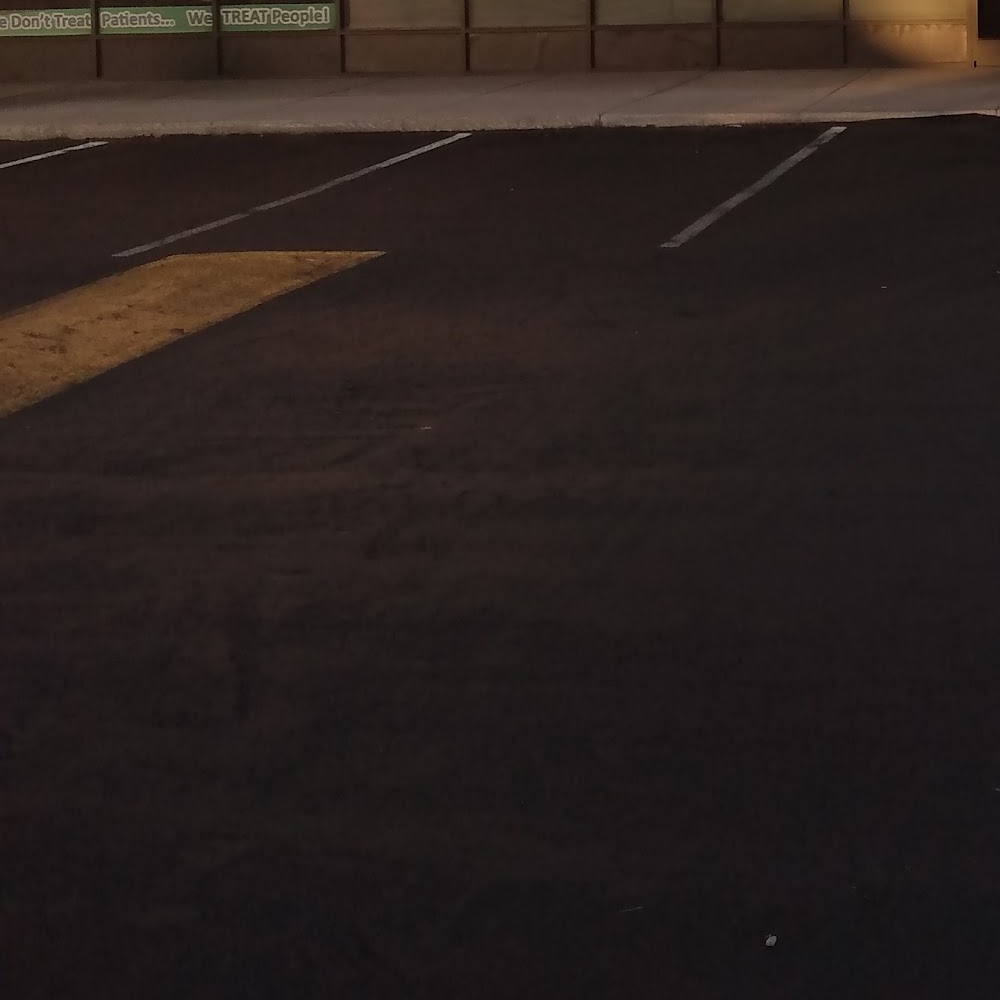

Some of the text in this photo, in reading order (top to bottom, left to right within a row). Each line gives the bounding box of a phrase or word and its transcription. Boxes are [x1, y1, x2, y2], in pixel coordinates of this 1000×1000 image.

[10, 12, 51, 29] Don't
[53, 12, 92, 29] Treat
[101, 11, 176, 28] Patients...
[186, 10, 212, 26] We
[221, 8, 269, 25] TREAT
[271, 6, 330, 27] People!
